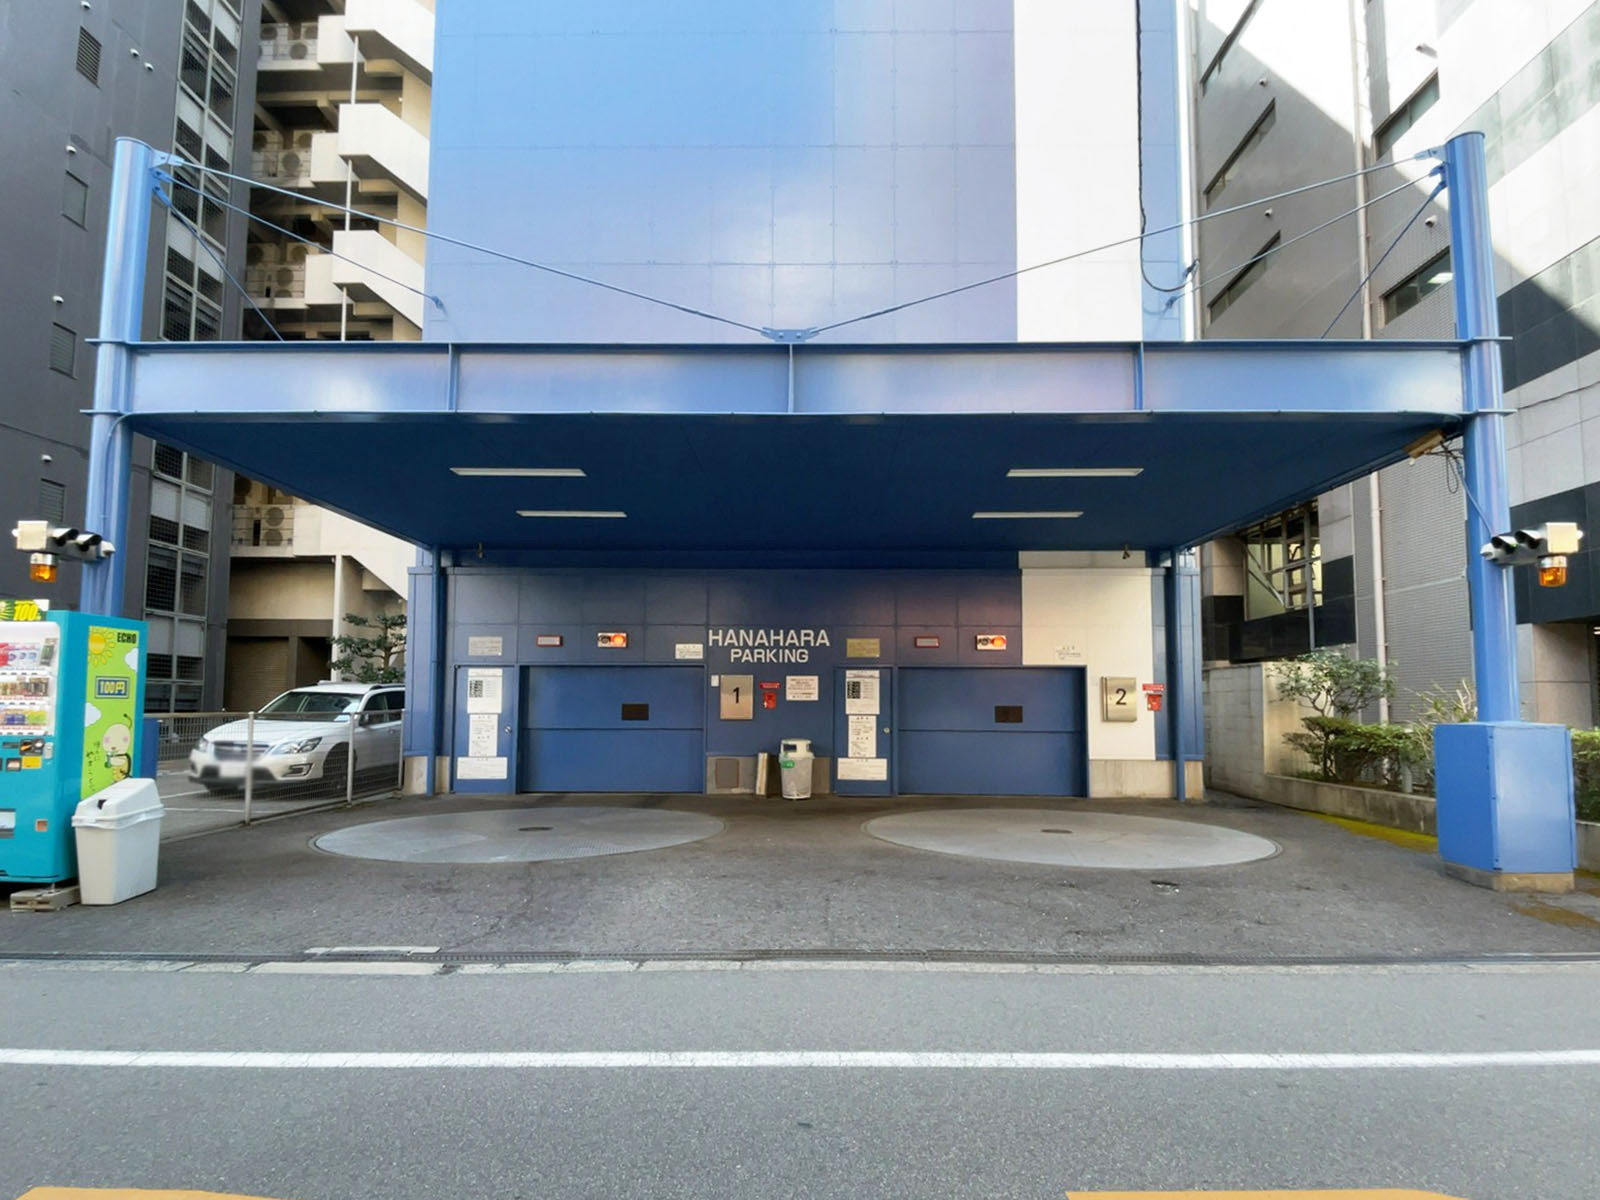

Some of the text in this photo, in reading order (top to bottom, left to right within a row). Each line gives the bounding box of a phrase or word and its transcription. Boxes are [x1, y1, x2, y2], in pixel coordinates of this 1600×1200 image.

[117, 632, 137, 644] ECHO
[708, 629, 830, 647] HANAHARA
[730, 649, 809, 663] PARKING
[100, 681, 126, 694] 100円
[733, 687, 740, 704] 1
[1115, 688, 1127, 705] 2
